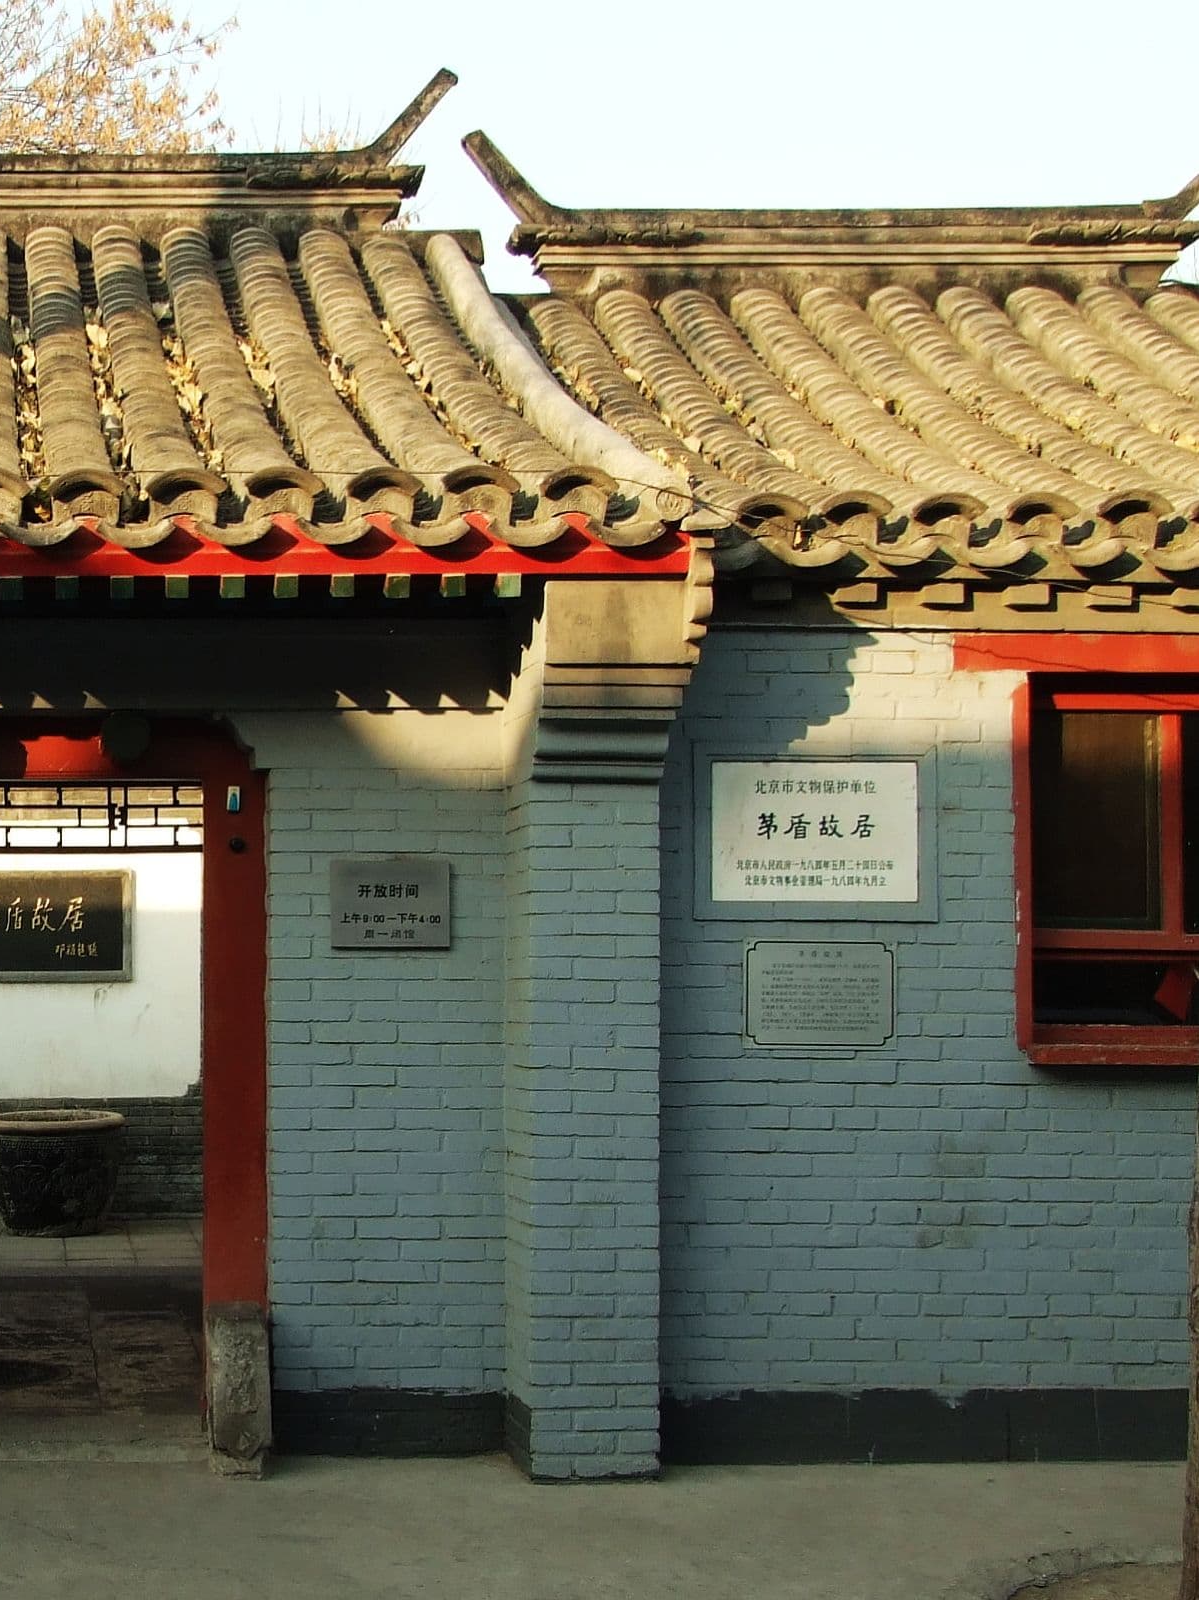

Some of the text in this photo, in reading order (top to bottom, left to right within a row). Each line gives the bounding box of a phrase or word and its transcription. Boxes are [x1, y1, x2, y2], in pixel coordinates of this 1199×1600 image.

[754, 779, 877, 794] 北京市文物保护单位
[757, 812, 876, 840] 茅盾故居
[357, 884, 419, 899] 开放时间
